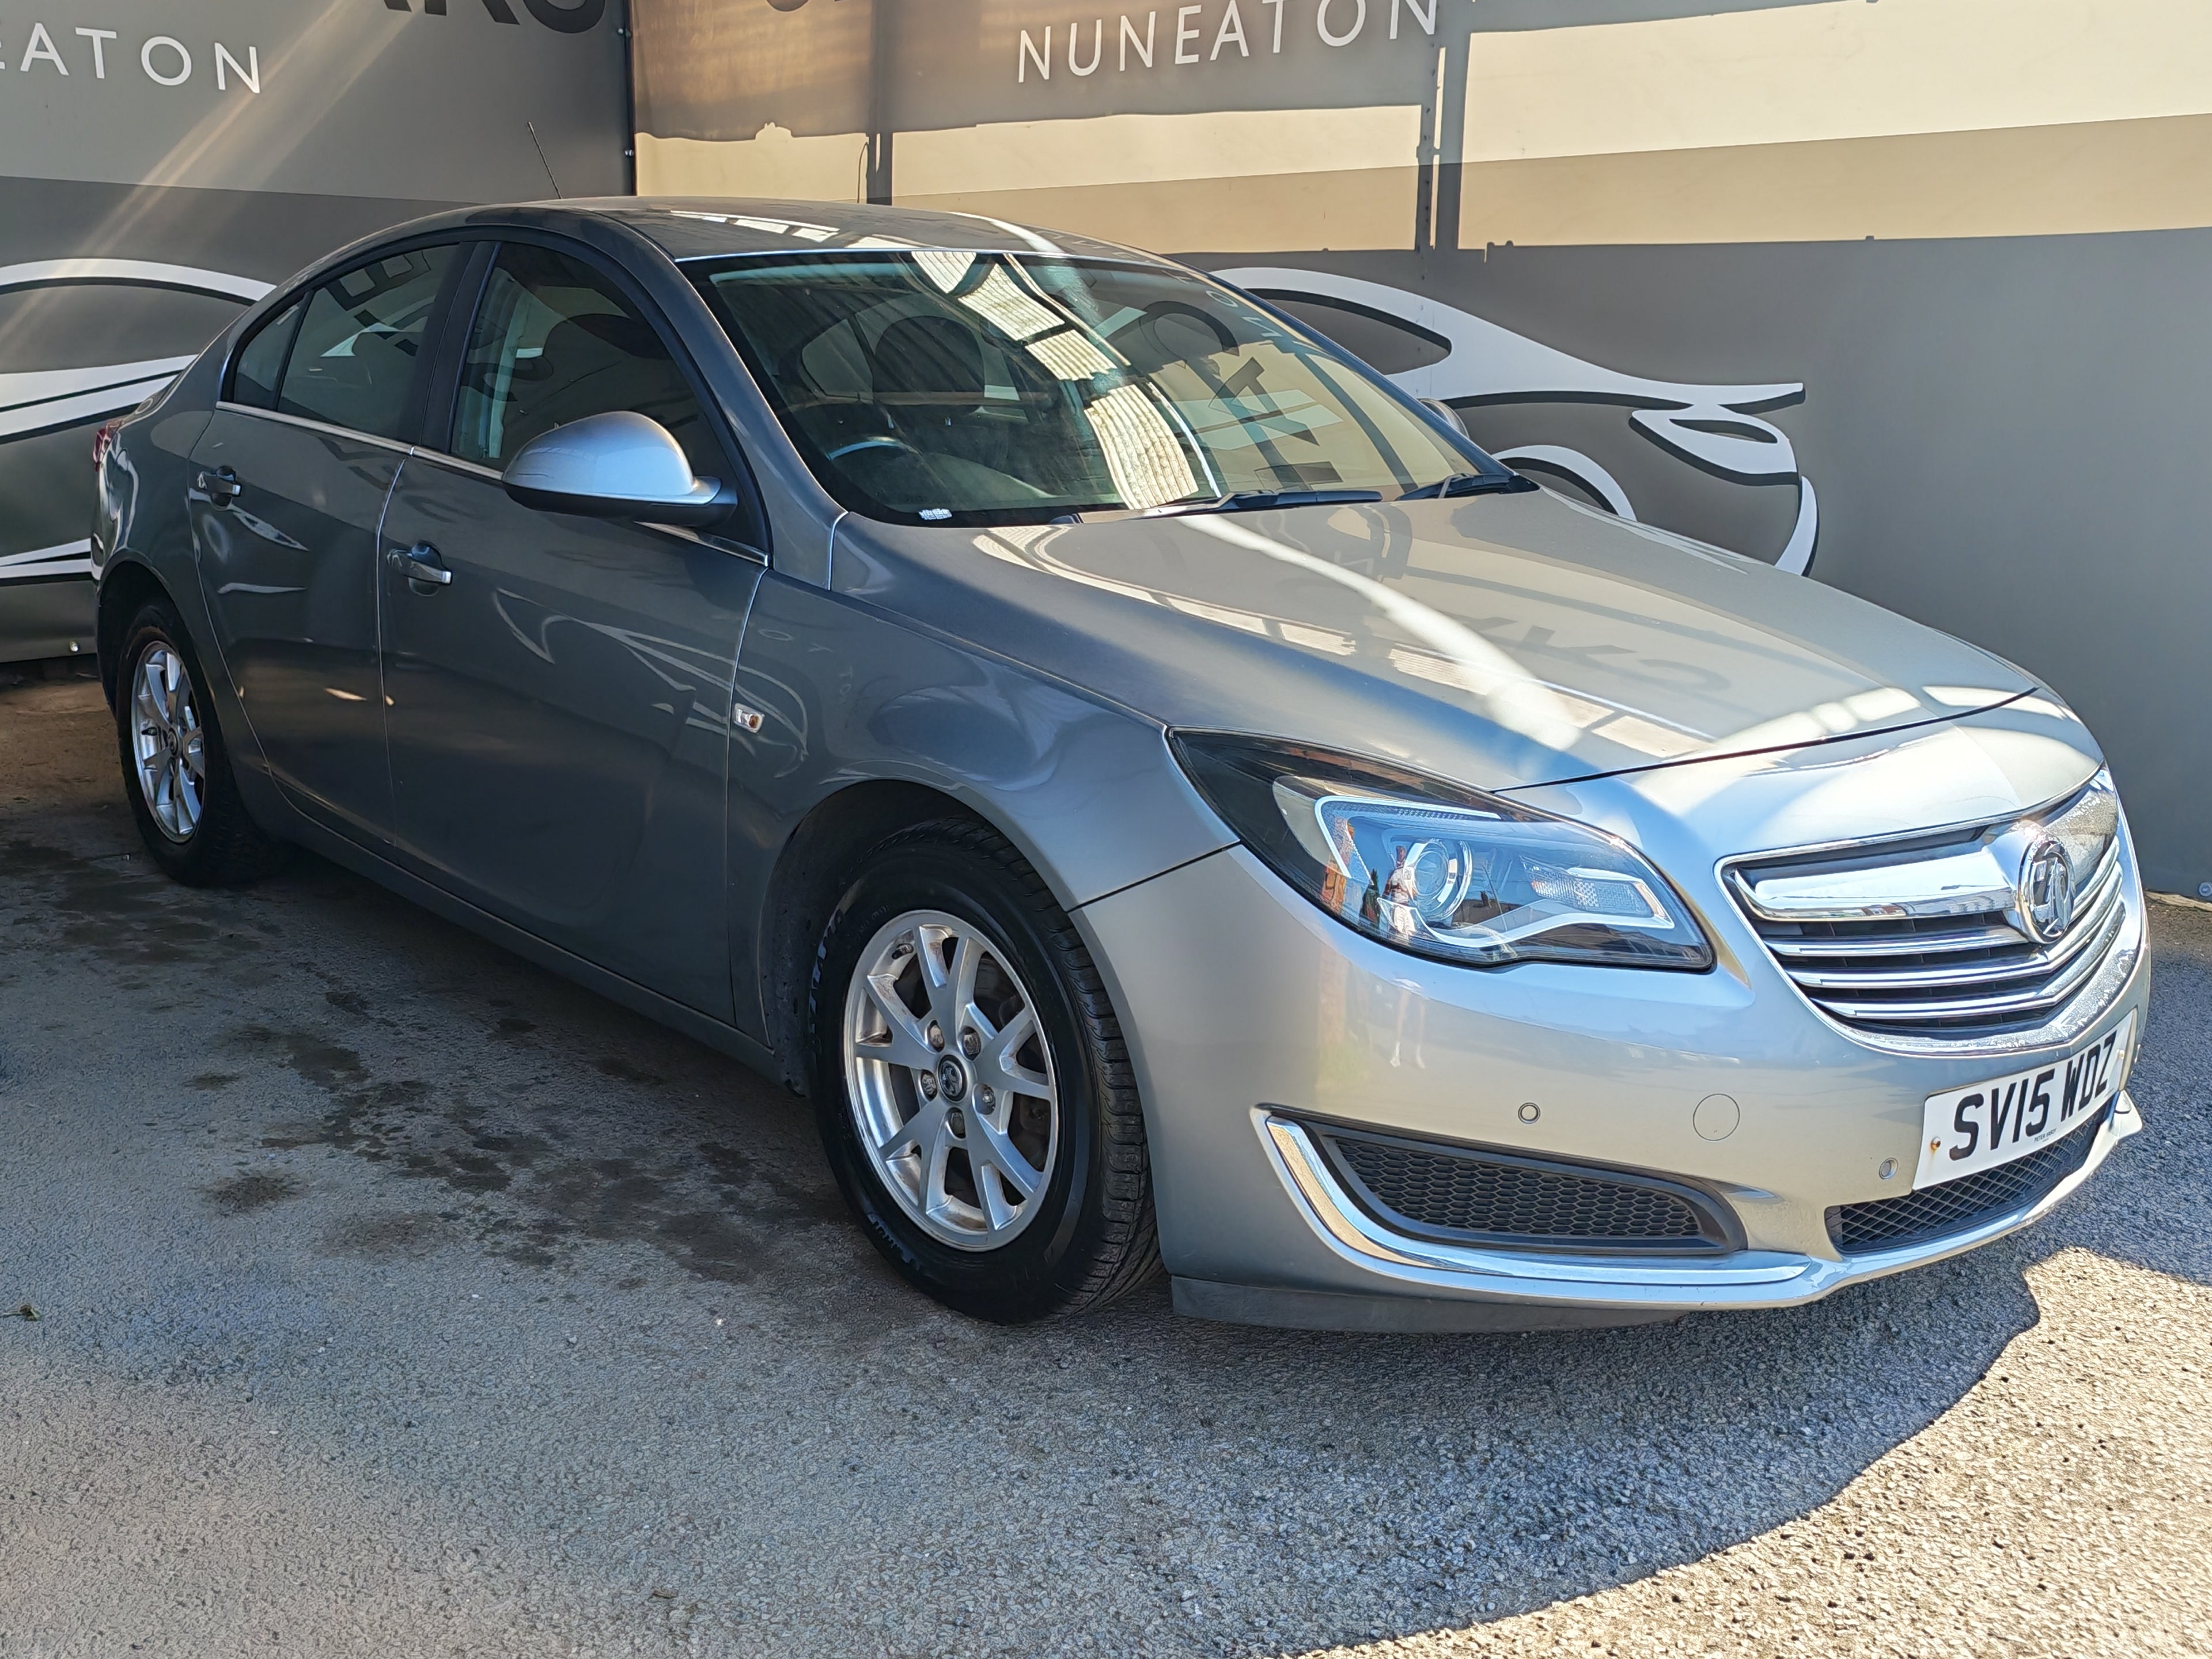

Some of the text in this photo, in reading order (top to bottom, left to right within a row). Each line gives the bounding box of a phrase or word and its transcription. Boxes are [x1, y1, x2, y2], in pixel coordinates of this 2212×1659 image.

[0, 22, 260, 94] ATON
[1018, 0, 1437, 83] NUNEATON
[1949, 1030, 2117, 1161] SV15 WDZ
